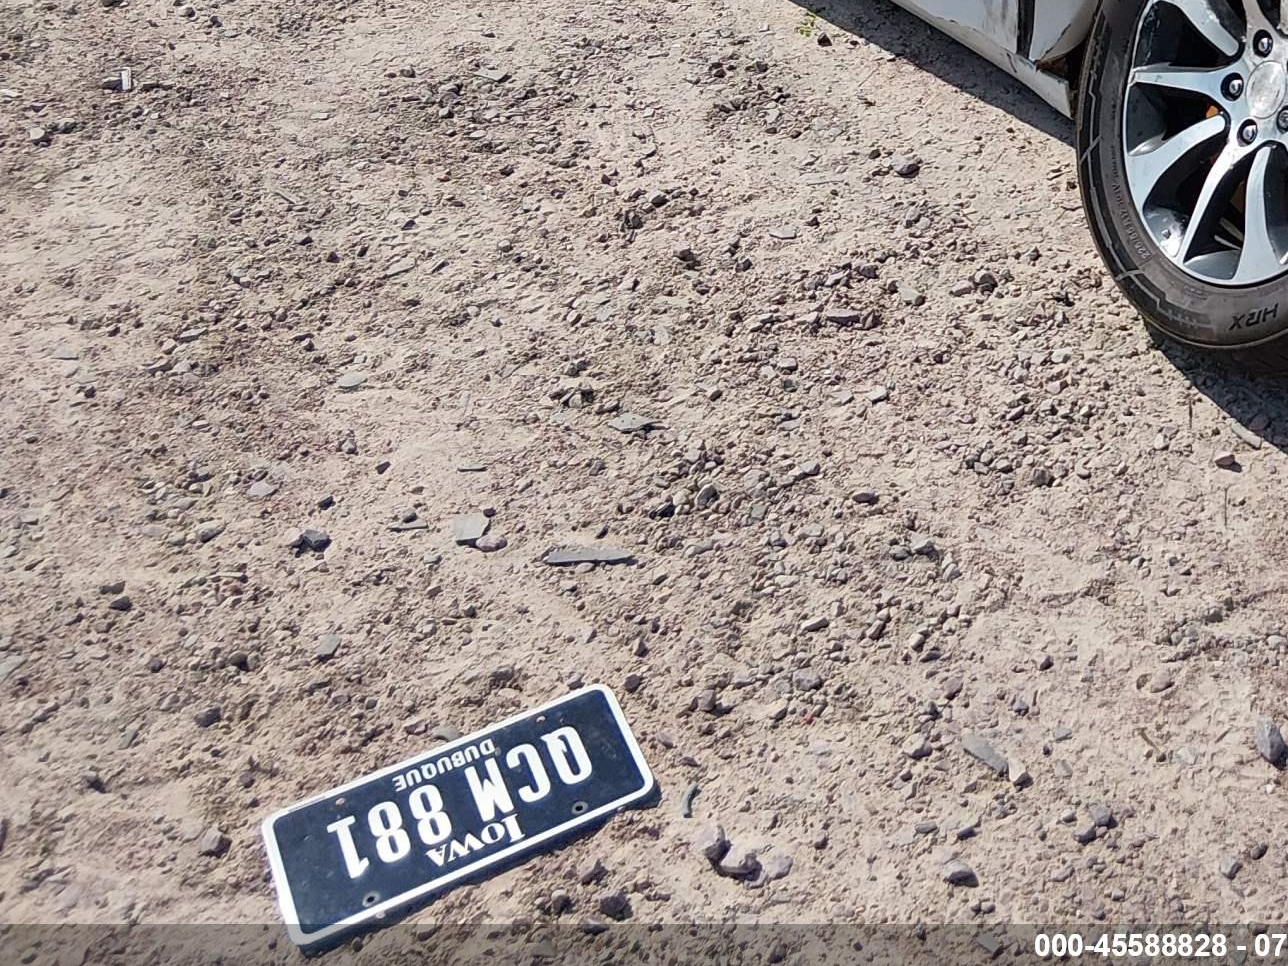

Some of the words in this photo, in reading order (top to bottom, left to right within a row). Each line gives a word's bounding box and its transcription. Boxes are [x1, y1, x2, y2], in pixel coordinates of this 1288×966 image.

[1228, 303, 1279, 331] HRX
[393, 738, 496, 792] DUBUQUE
[465, 726, 592, 822] QCM
[327, 785, 451, 878] 881
